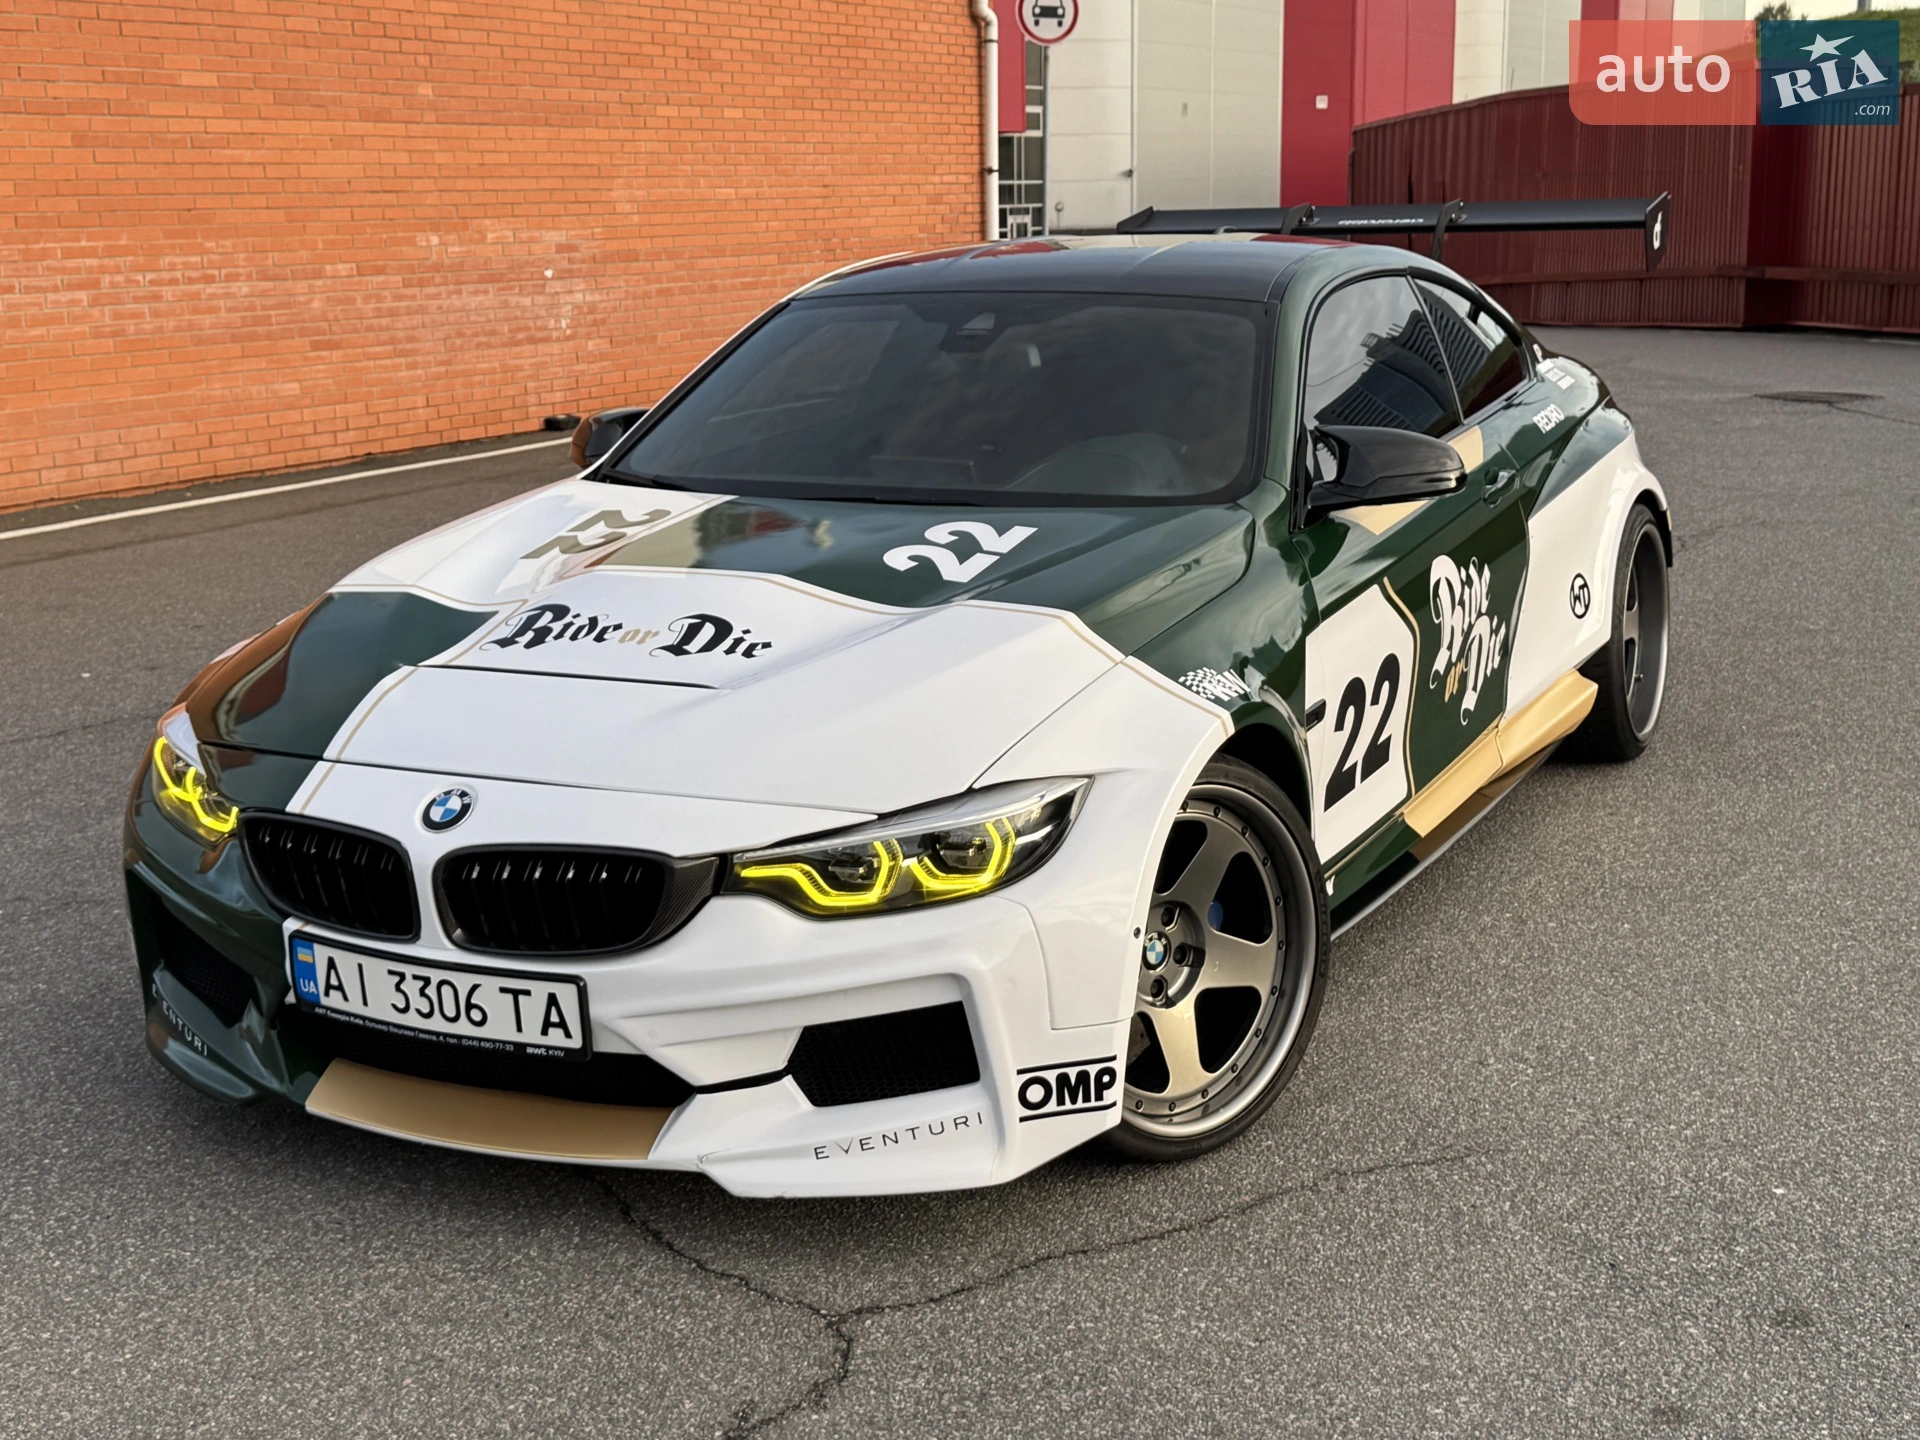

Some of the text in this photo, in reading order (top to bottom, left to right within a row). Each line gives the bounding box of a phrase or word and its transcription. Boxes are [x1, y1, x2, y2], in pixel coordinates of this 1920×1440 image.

[519, 508, 672, 559] 22
[884, 521, 1039, 583] 22
[479, 603, 773, 659] Ride or Die
[1429, 554, 1492, 690] Ride
[1460, 614, 1507, 727] Die
[1323, 652, 1402, 814] 22
[299, 977, 319, 995] UA
[323, 955, 573, 1040] AI 3306 TA
[152, 983, 208, 1057] EENTURI
[461, 1037, 480, 1048] (044)
[1017, 1065, 1118, 1112] OMP
[813, 1110, 983, 1160] EVENTURI
